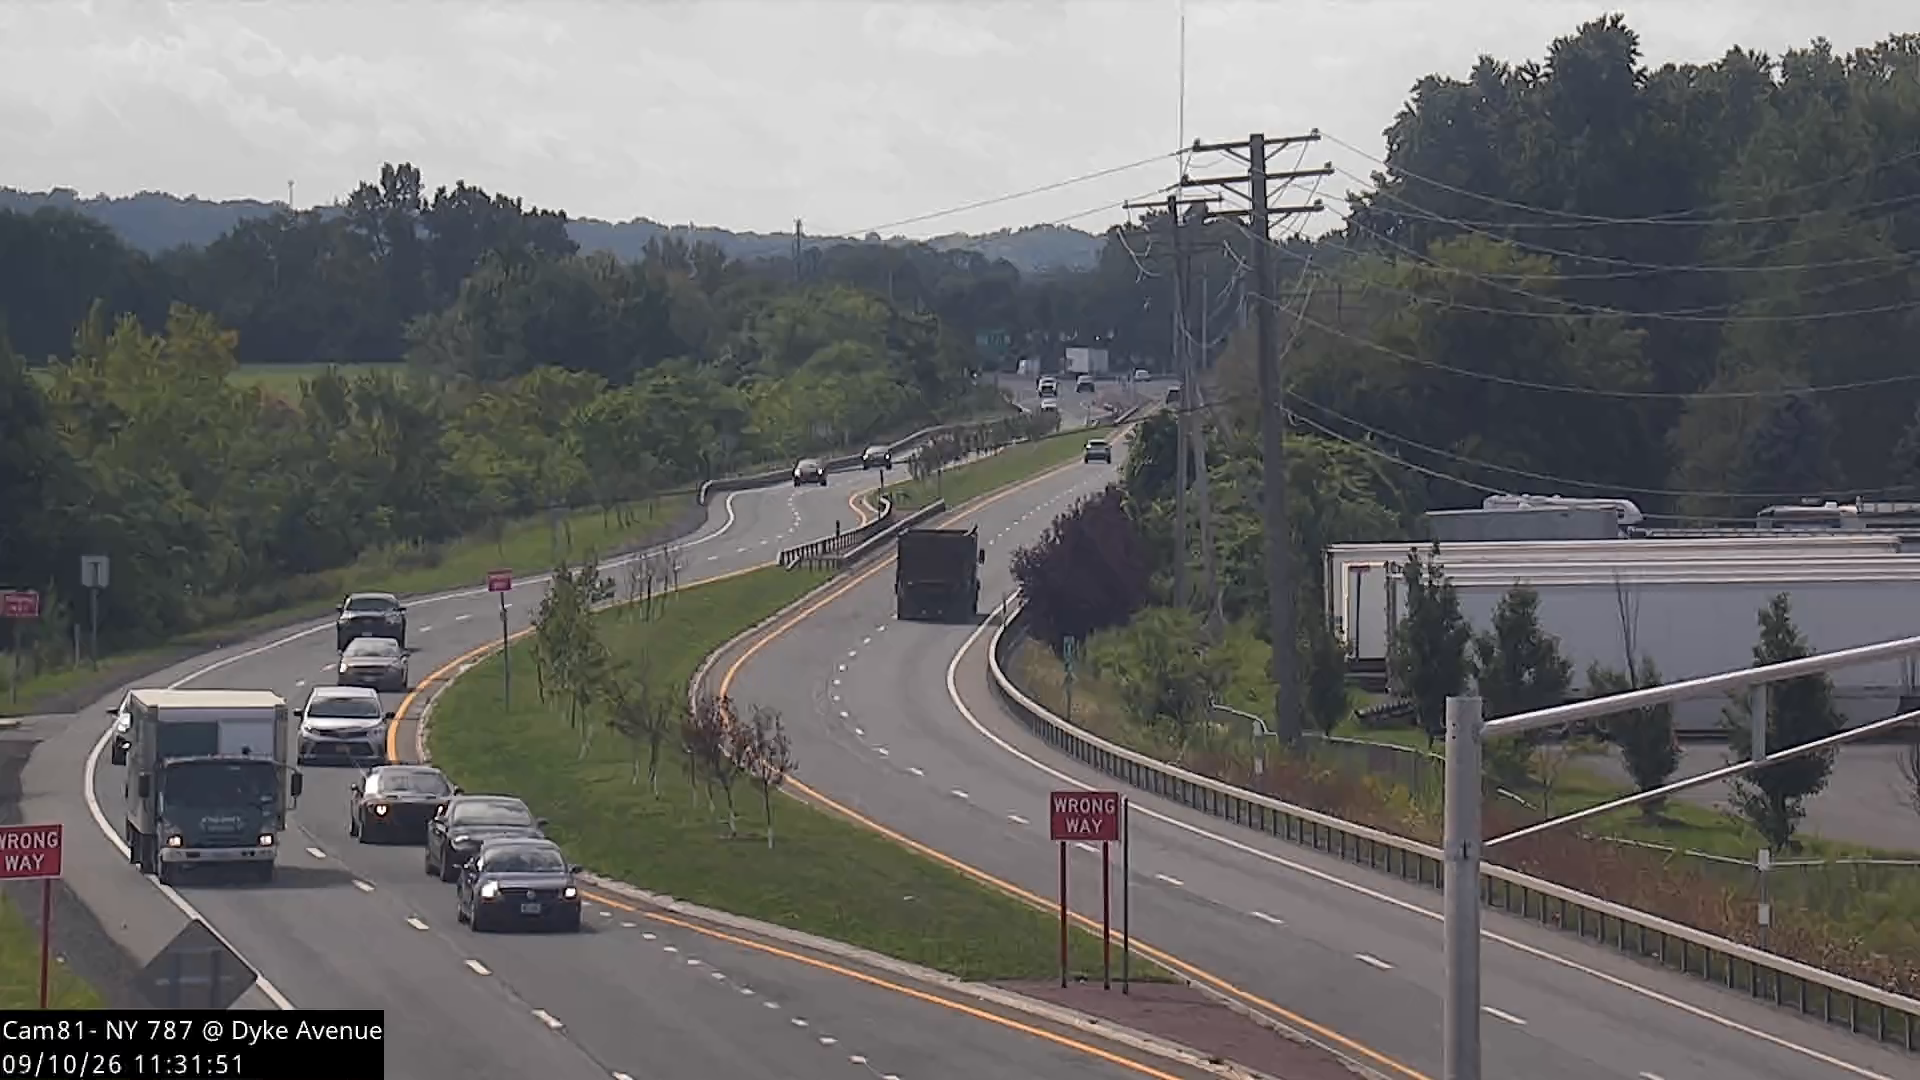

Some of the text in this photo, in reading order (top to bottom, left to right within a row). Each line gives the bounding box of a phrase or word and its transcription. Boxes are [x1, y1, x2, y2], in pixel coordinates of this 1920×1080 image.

[1054, 797, 1115, 814] WRONG
[1065, 818, 1103, 834] WAY
[5, 854, 45, 871] WAY
